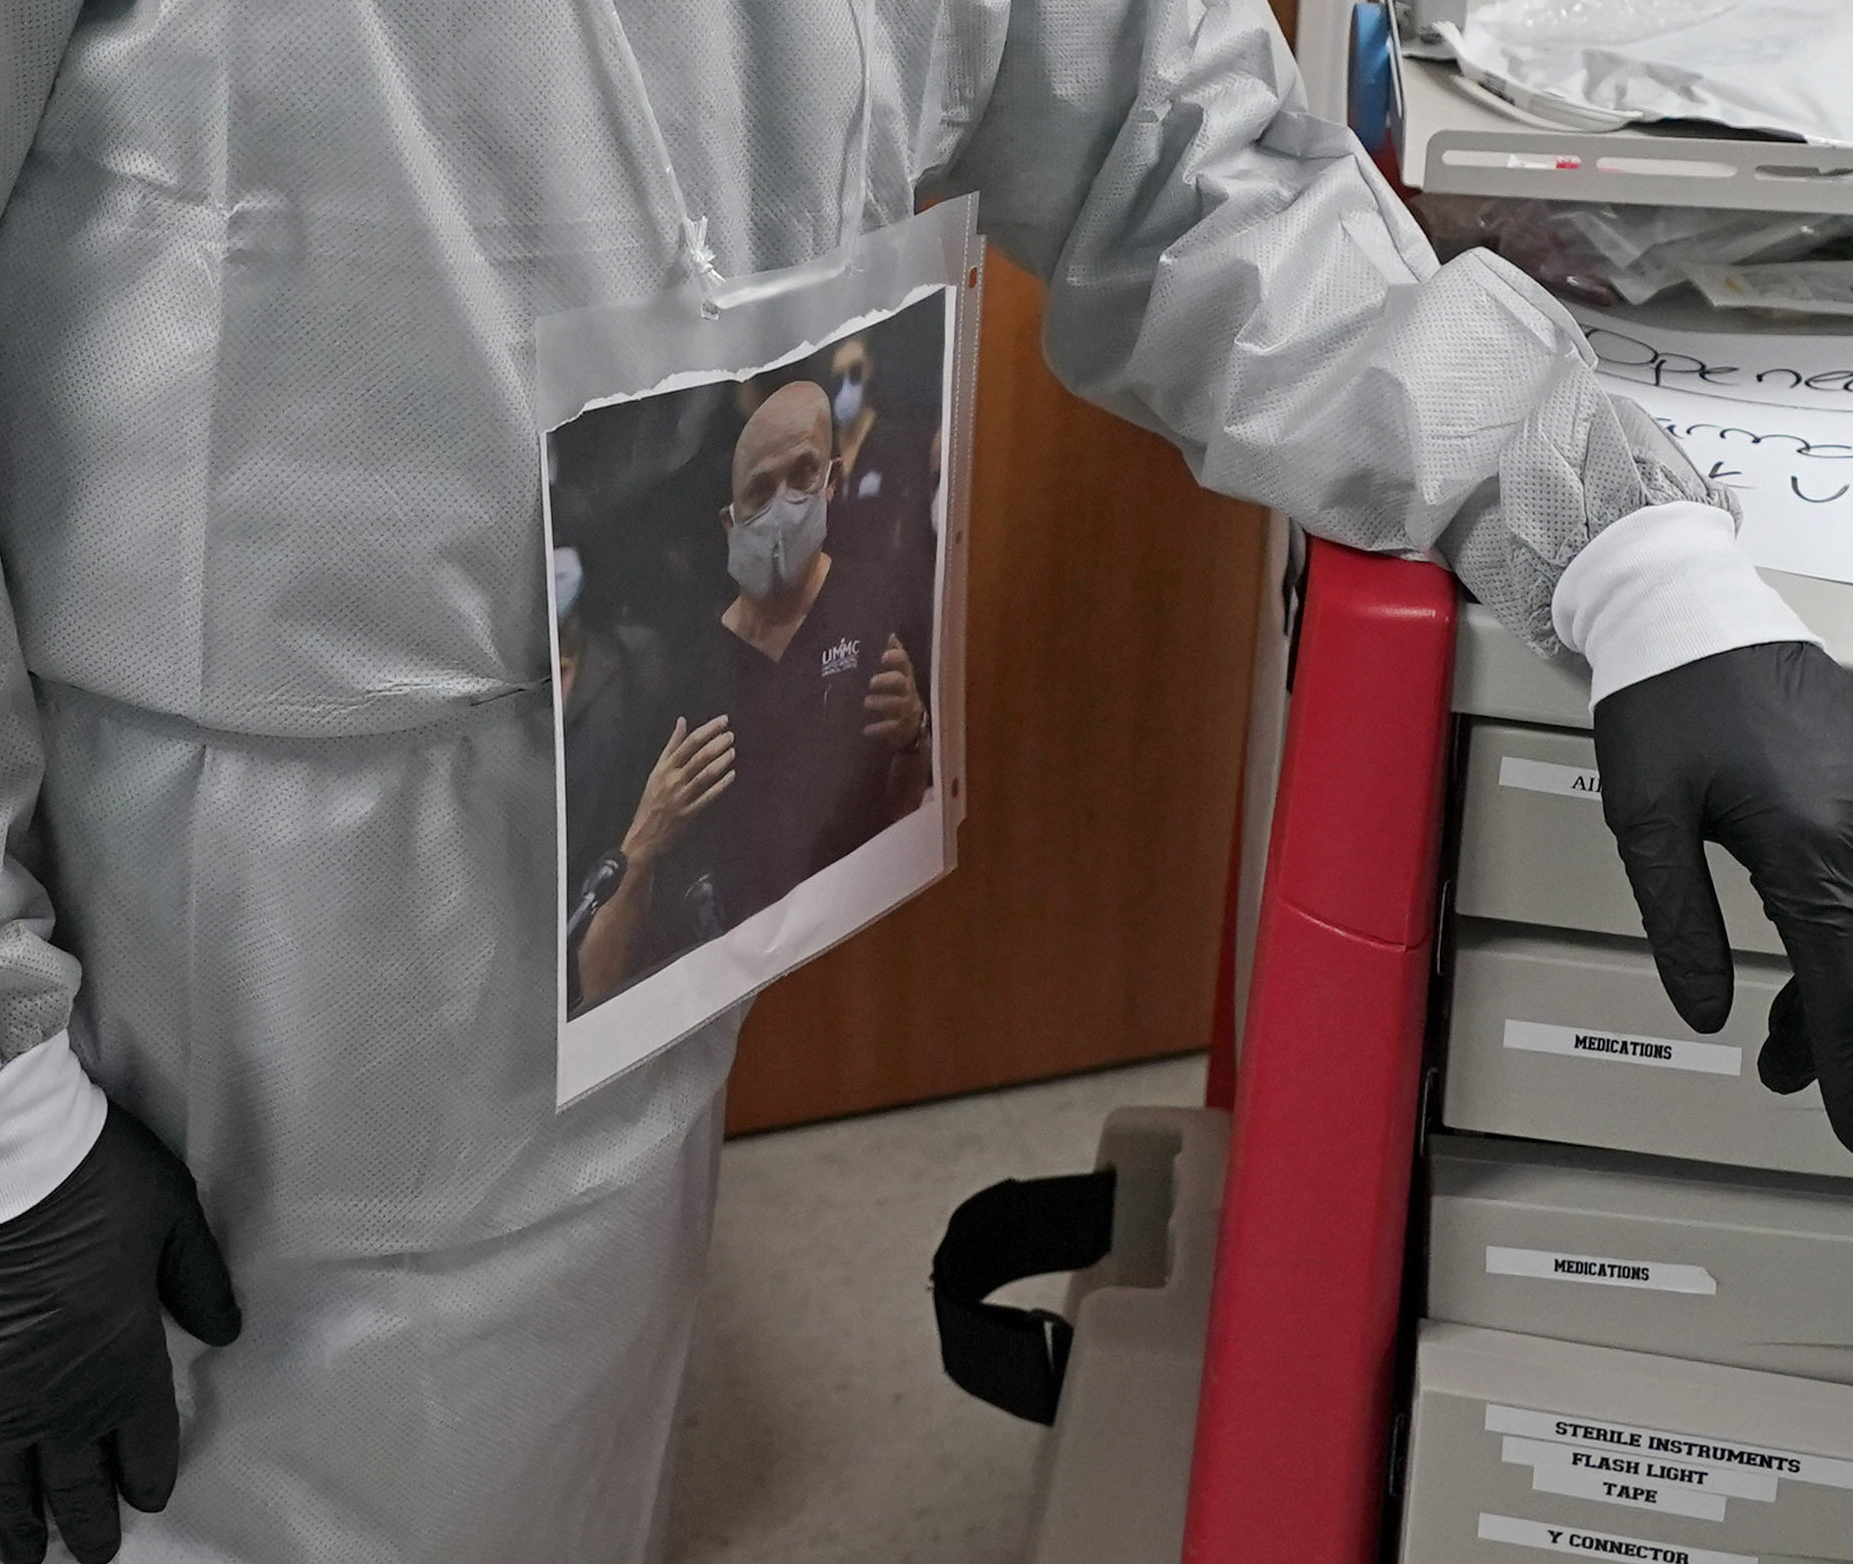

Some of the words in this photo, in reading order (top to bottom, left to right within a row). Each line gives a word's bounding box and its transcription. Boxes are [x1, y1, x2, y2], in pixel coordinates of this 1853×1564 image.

[1573, 1034, 1673, 1060] MEDICATIONS
[1553, 1258, 1650, 1281] MEDICATIONS
[1555, 1421, 1642, 1448] STERILE
[1648, 1435, 1801, 1473] INSTRUMENTS
[1571, 1452, 1640, 1475] FLASH
[1645, 1463, 1709, 1486] LIGHT
[1602, 1481, 1658, 1504] TAPE
[1547, 1529, 1564, 1544] Y
[1568, 1533, 1690, 1564] CONNECTOR
